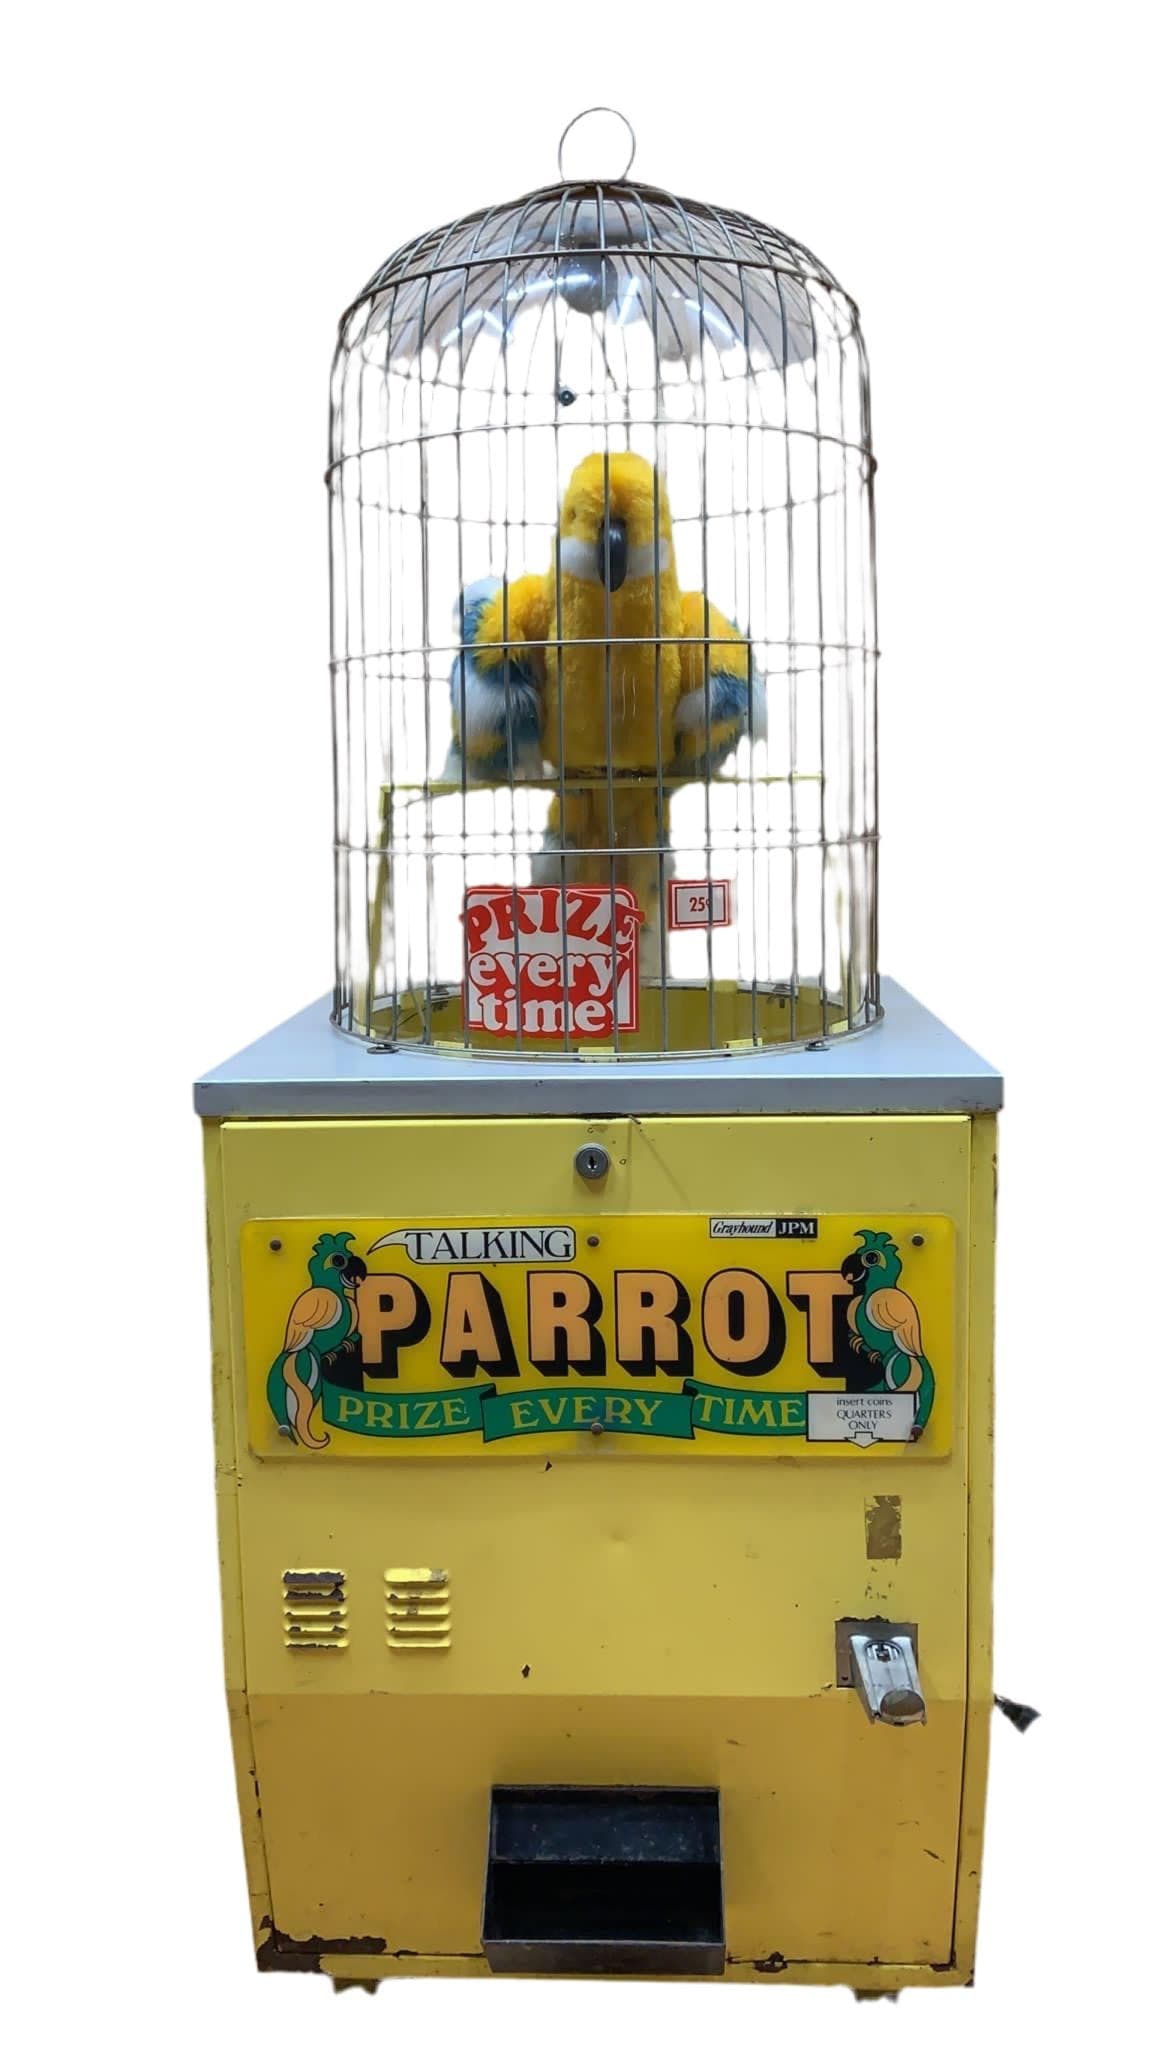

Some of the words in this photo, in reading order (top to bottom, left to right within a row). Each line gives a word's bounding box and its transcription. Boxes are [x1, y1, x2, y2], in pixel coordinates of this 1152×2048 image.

[460, 888, 645, 955] PRIZE
[469, 952, 622, 997] every
[479, 988, 606, 1033] time
[404, 1228, 572, 1260] TALKING
[712, 1221, 773, 1235] Grayhound
[778, 1221, 815, 1235] JPM
[356, 1267, 854, 1379] PARROT
[337, 1394, 470, 1430] PRIZE
[509, 1395, 663, 1430] EVERY
[697, 1393, 806, 1428] TIME
[836, 1397, 864, 1406] insert
[867, 1397, 893, 1406] coins
[836, 1409, 892, 1420] QUARTERS
[848, 1420, 878, 1430] ONLY
